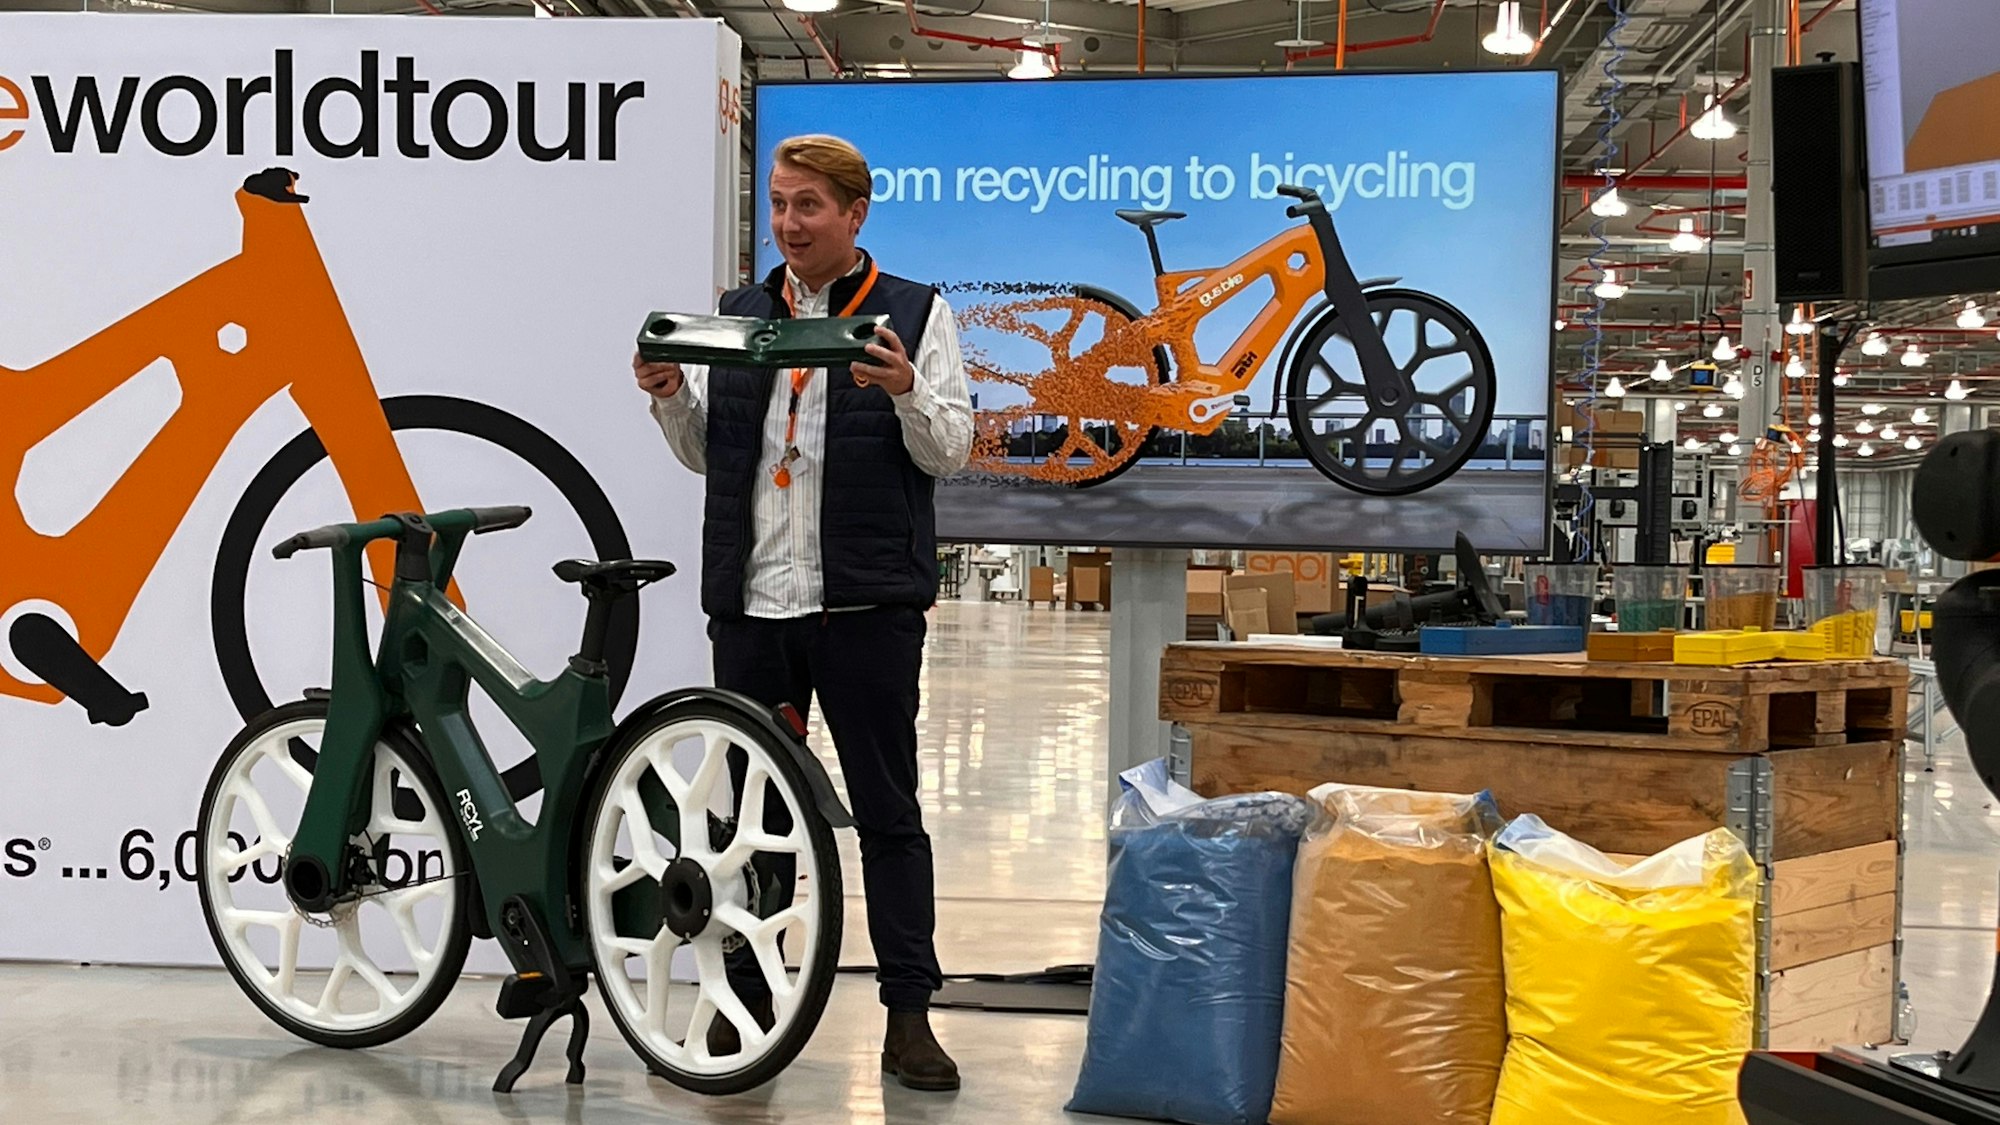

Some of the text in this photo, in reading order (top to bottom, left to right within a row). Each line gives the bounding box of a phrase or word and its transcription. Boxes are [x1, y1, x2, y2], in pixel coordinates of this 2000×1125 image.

[870, 151, 1476, 213] om recycling to bicycling
[1692, 708, 1732, 728] EPAL
[456, 788, 484, 841] RCYL
